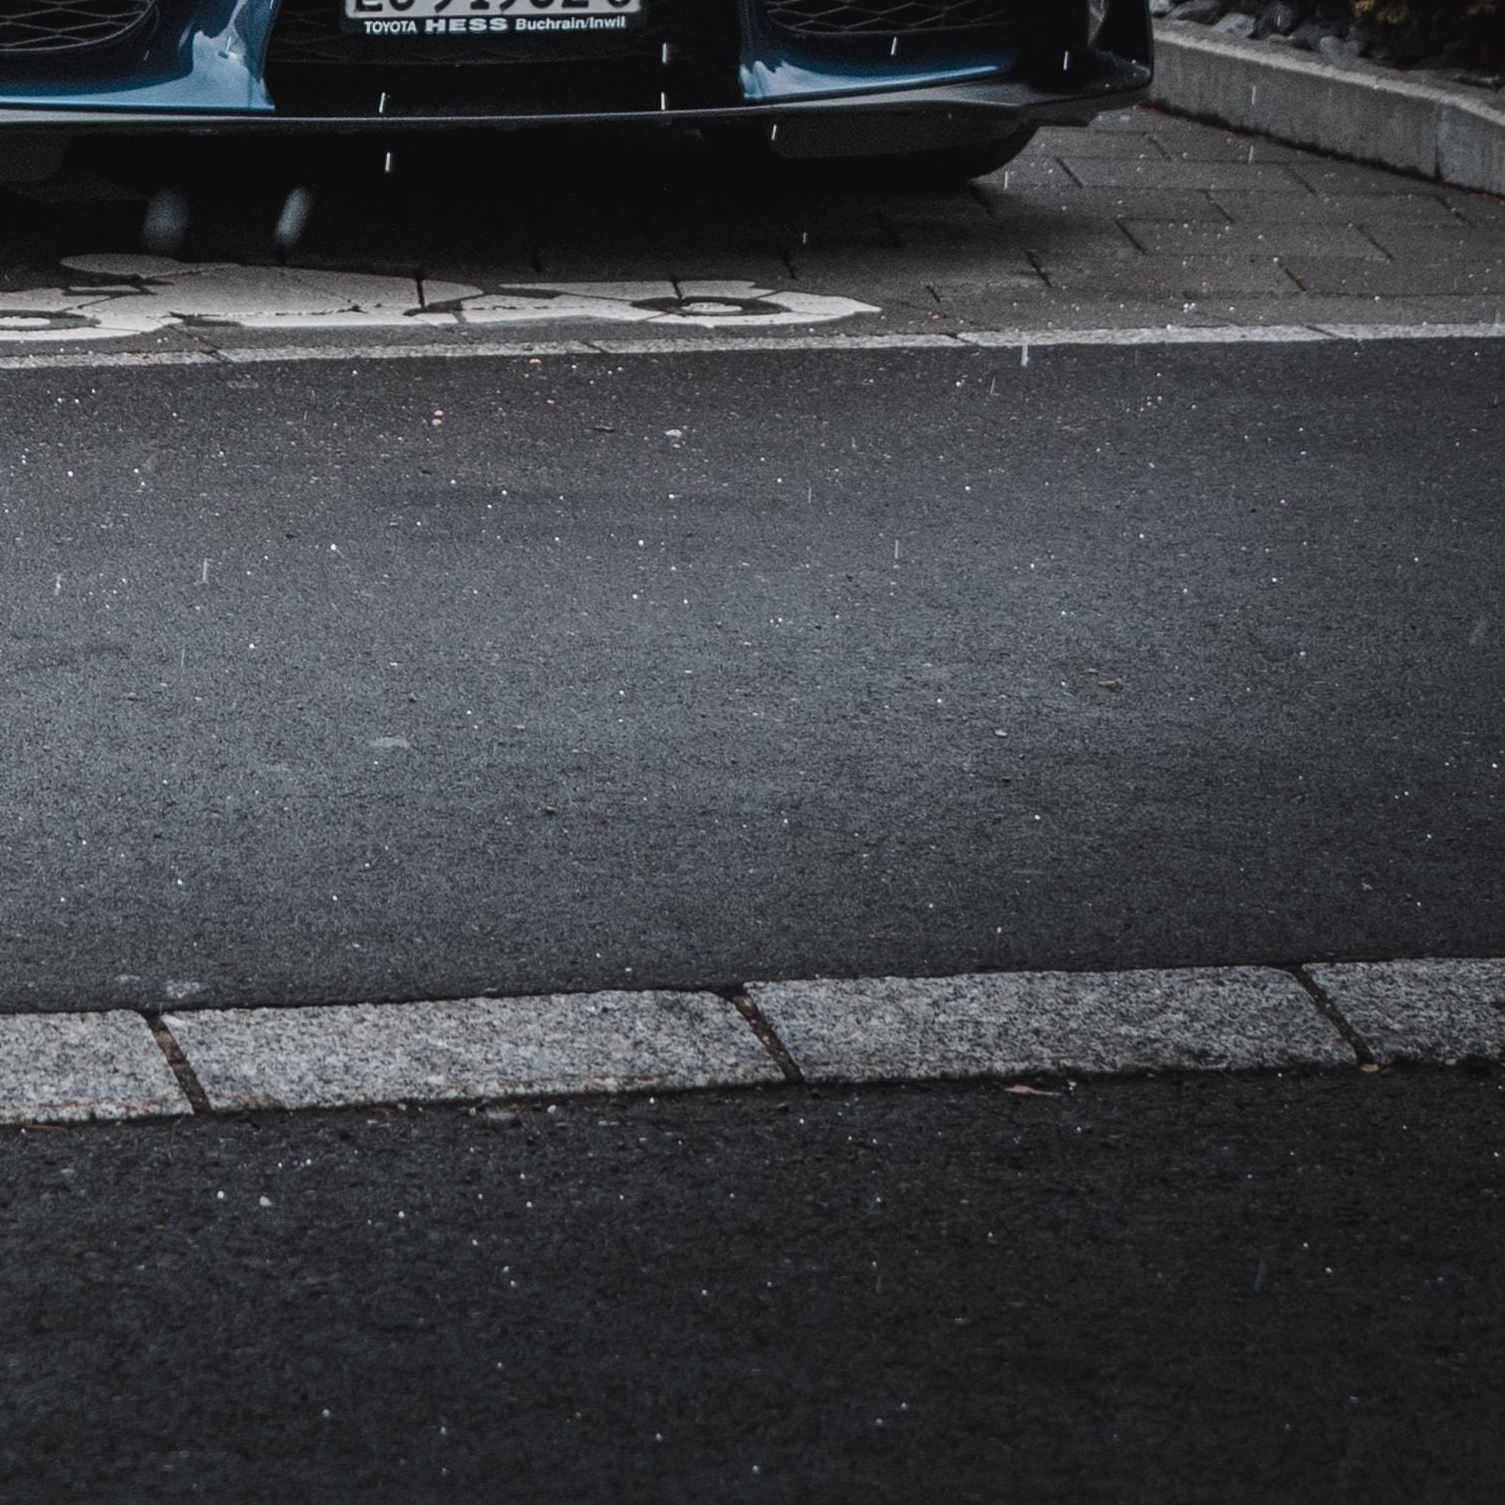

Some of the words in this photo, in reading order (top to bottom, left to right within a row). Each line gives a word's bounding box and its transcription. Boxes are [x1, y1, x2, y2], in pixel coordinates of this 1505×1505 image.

[364, 20, 417, 34] TOYOTA
[425, 17, 509, 33] HESS
[515, 15, 627, 32] Buchrain/Inwil
